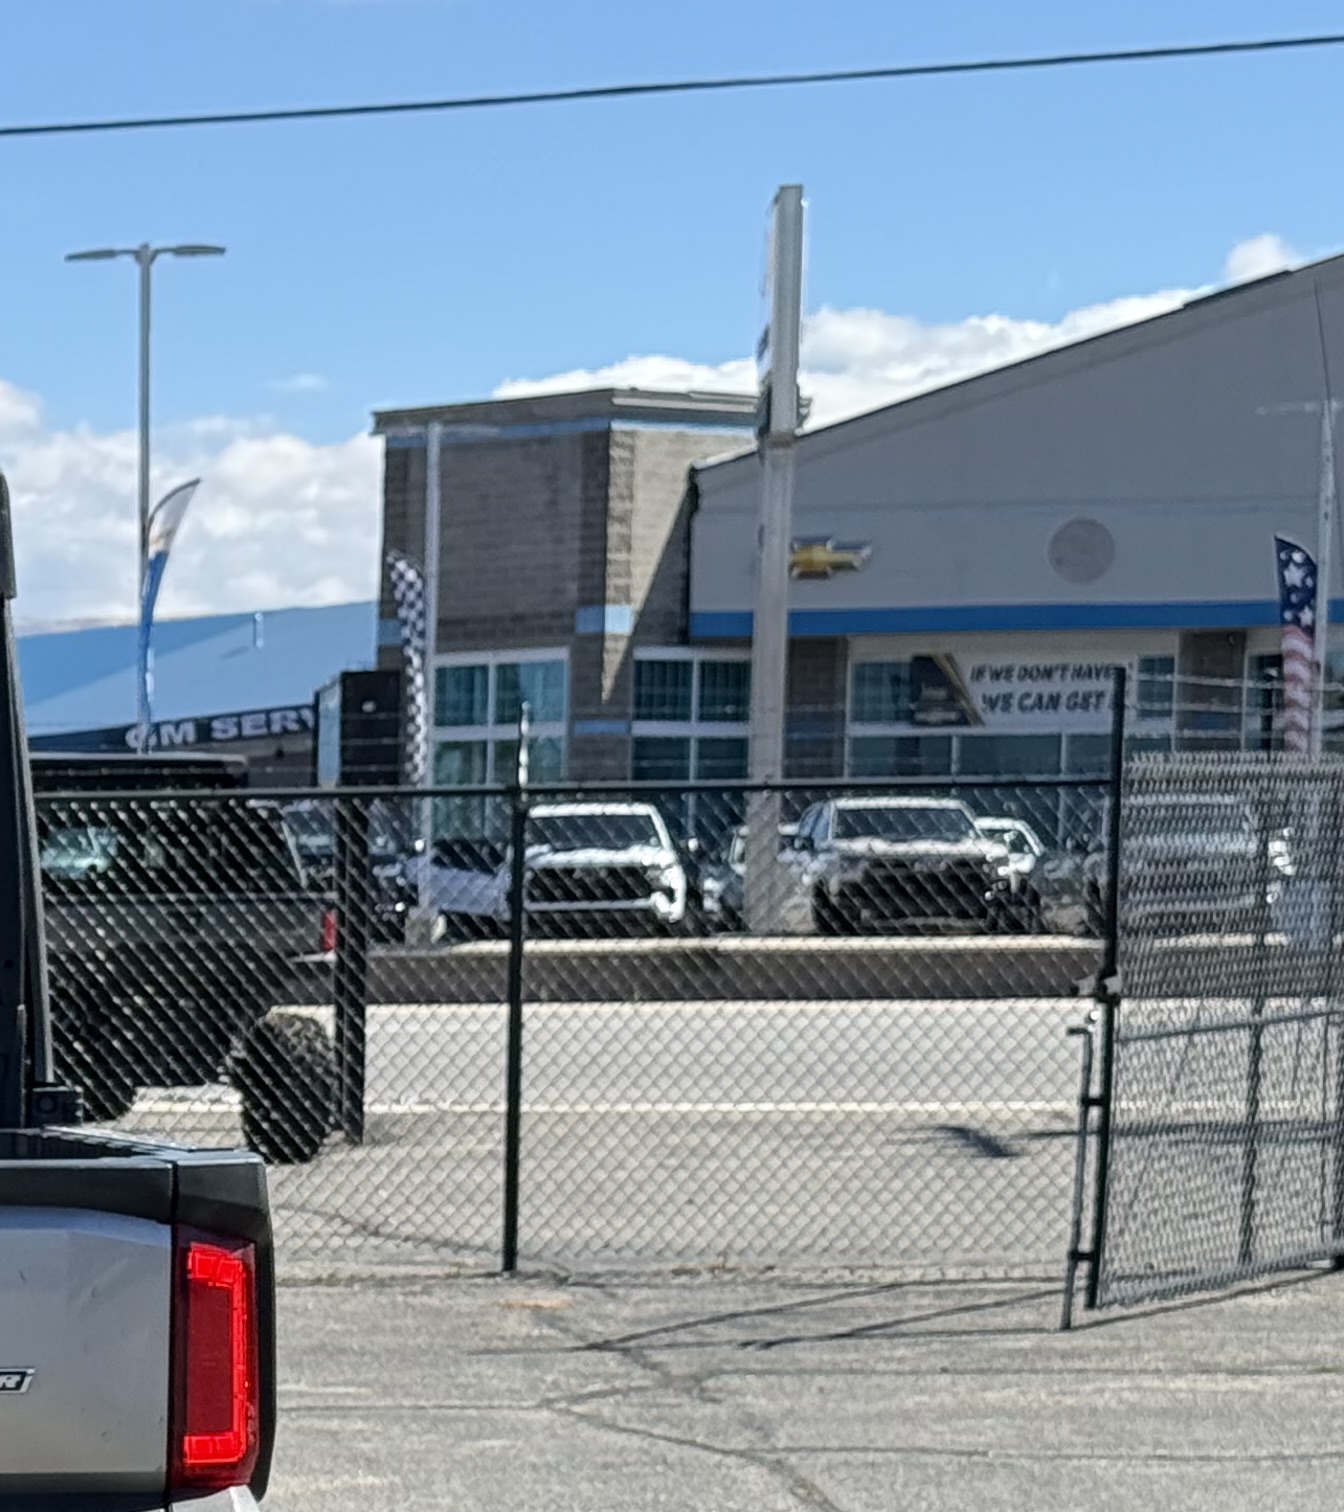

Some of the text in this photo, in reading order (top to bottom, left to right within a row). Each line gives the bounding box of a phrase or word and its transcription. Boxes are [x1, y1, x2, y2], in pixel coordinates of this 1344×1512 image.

[970, 664, 987, 682] IF
[989, 664, 1014, 683] WE
[1017, 663, 1069, 681] DON'T
[982, 691, 1012, 713] WE
[1017, 691, 1061, 713] CAN
[1066, 690, 1105, 712] GET
[125, 721, 195, 749] GM
